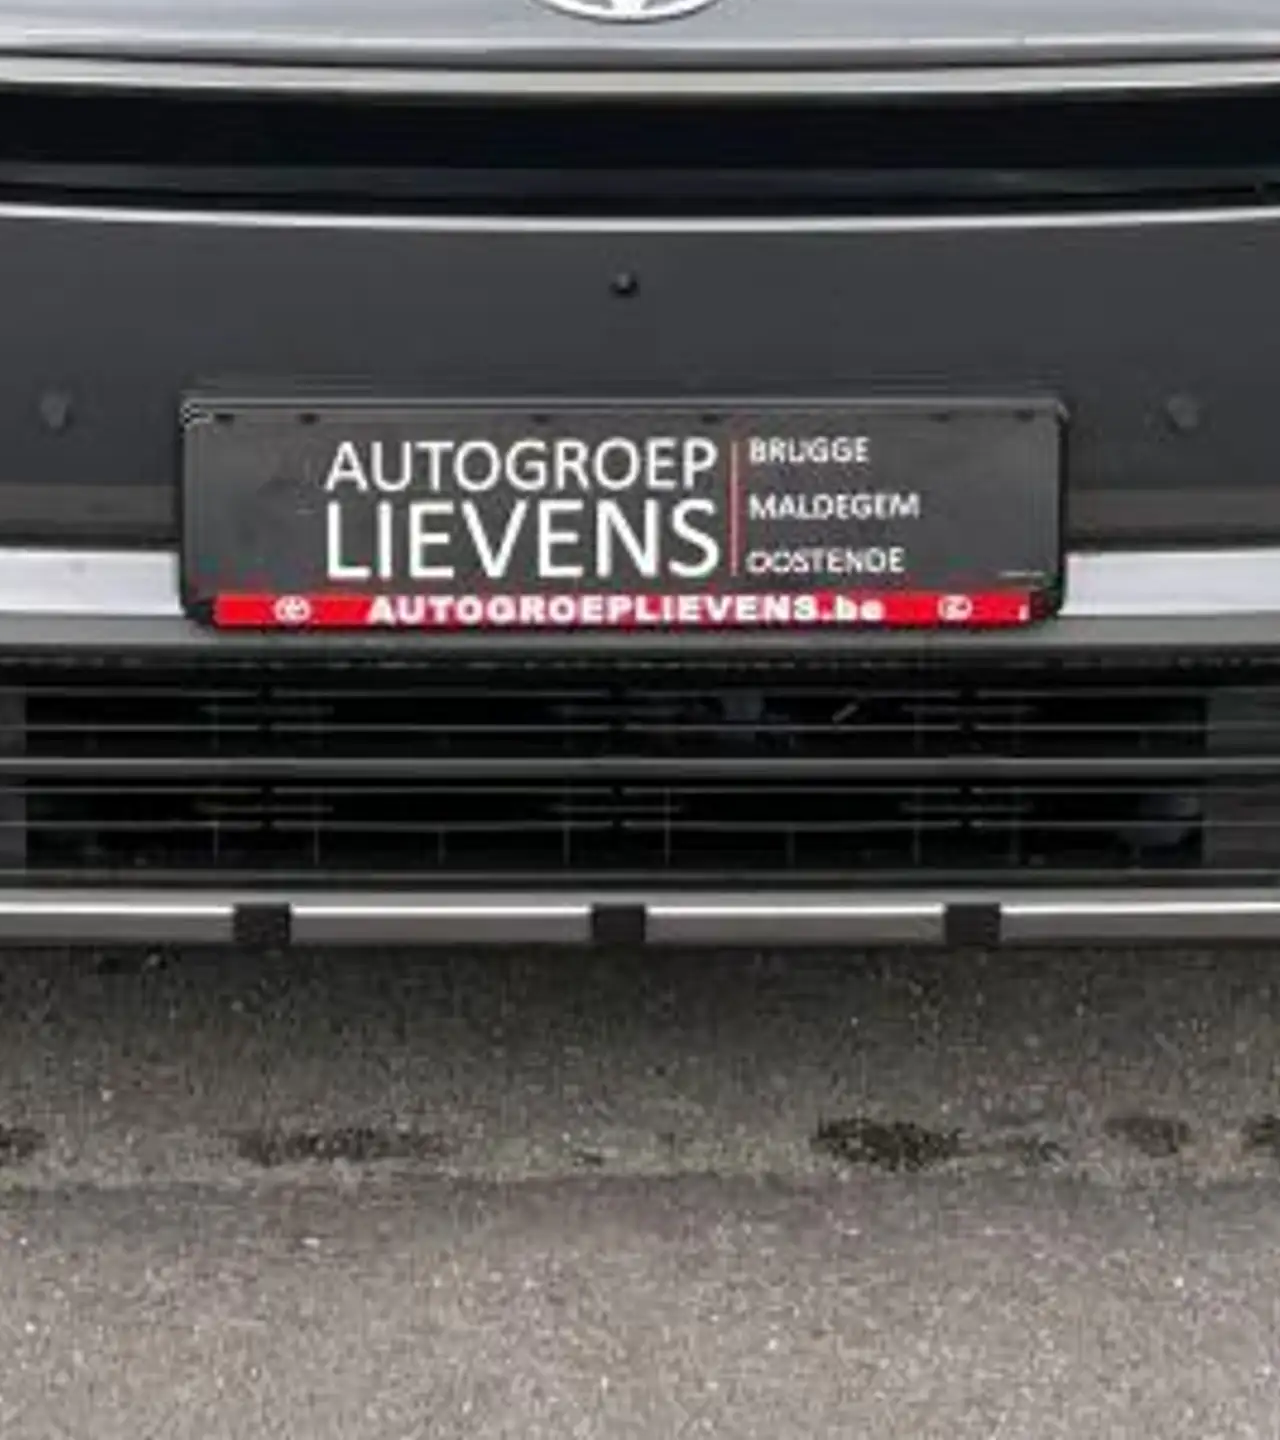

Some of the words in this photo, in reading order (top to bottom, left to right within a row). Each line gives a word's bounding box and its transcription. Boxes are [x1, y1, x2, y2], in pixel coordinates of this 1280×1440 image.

[325, 436, 718, 492] AUTOGROEP
[749, 437, 870, 463] BRUGGE
[749, 493, 919, 520] MALDEGEM
[327, 499, 720, 580] LIEVENS
[746, 547, 906, 574] OOSTENDE
[367, 594, 887, 624] AUTOGROEPLIEVENS.be
